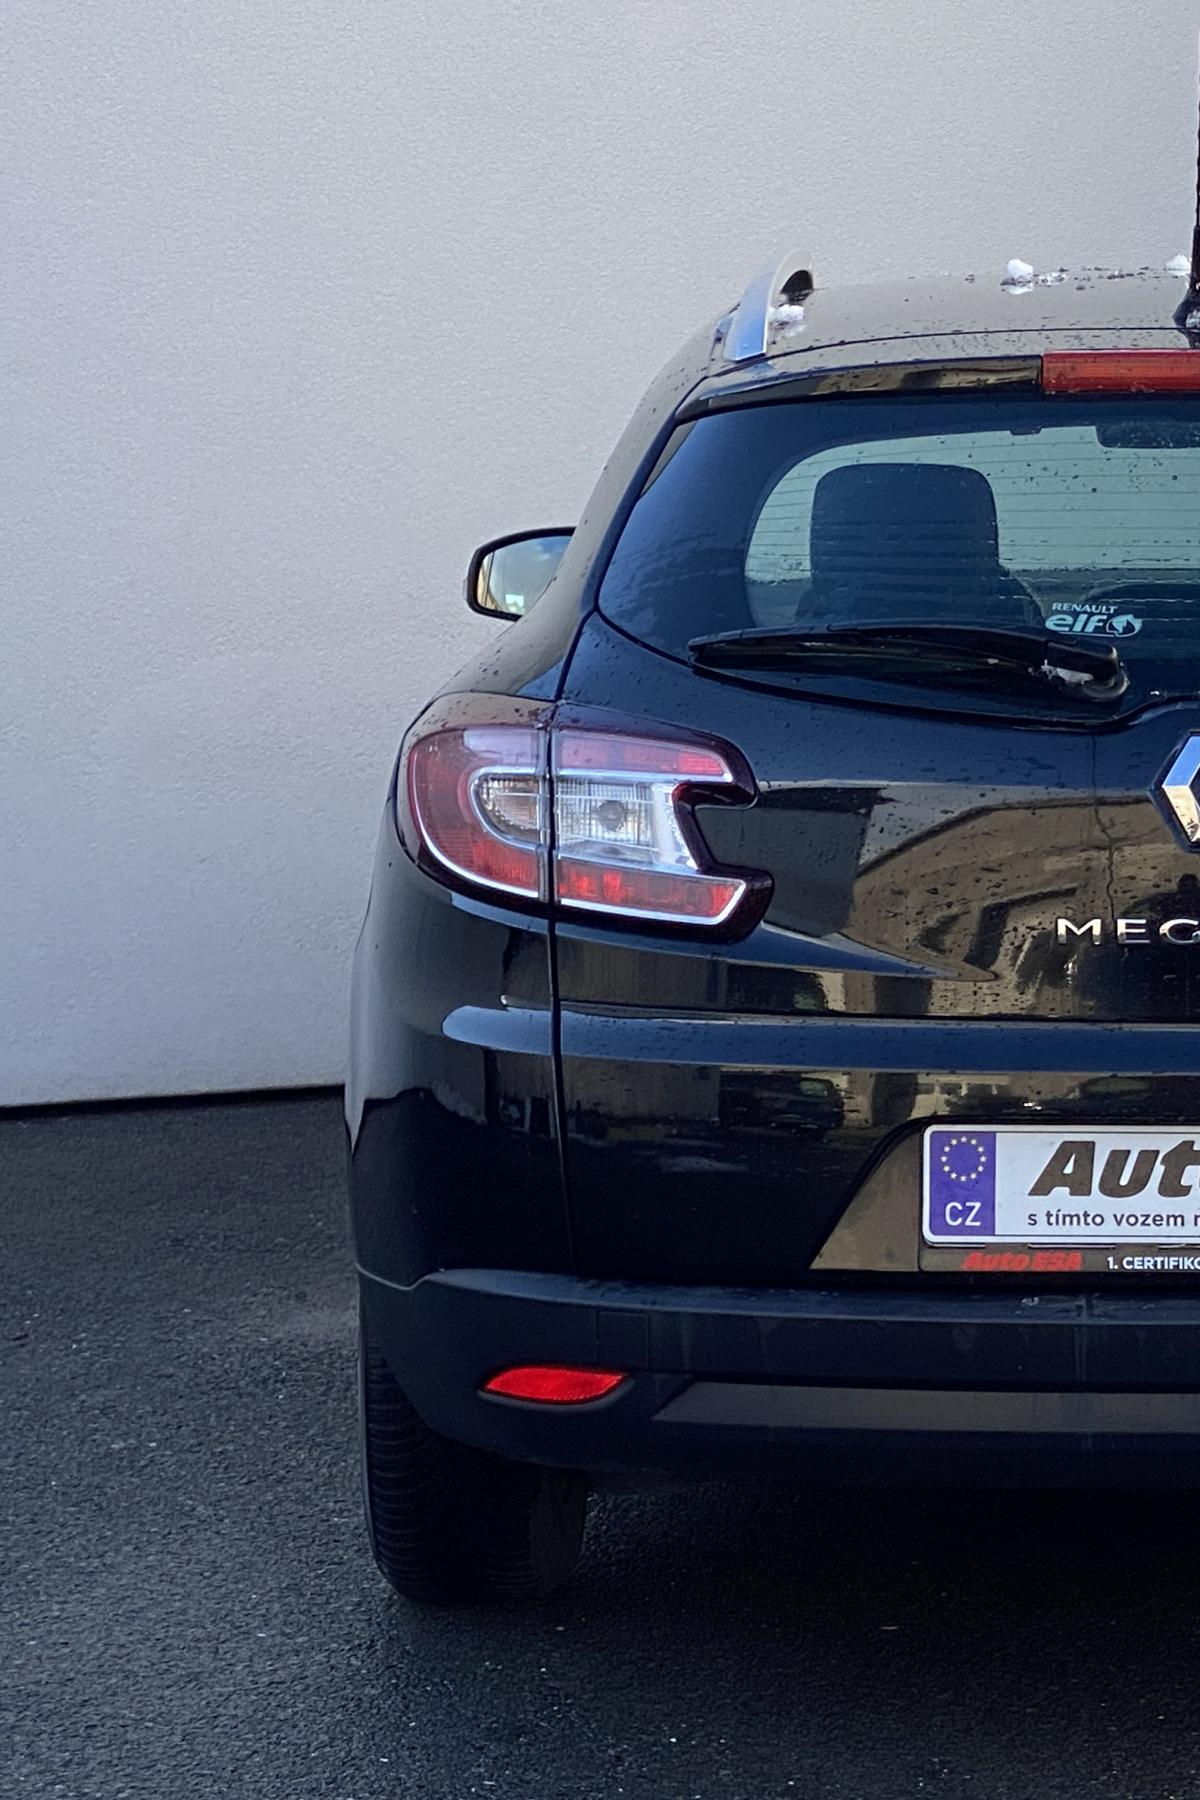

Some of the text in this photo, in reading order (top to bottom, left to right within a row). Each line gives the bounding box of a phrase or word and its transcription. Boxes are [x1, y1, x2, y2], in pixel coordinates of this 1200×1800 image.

[1052, 602, 1118, 614] RENAULT
[944, 1202, 982, 1226] CZ
[1027, 1213, 1038, 1226] s
[1045, 1209, 1105, 1227] tímto
[1113, 1213, 1185, 1227] vozem
[1031, 1252, 1082, 1271] ESA
[1107, 1256, 1119, 1269] 1.
